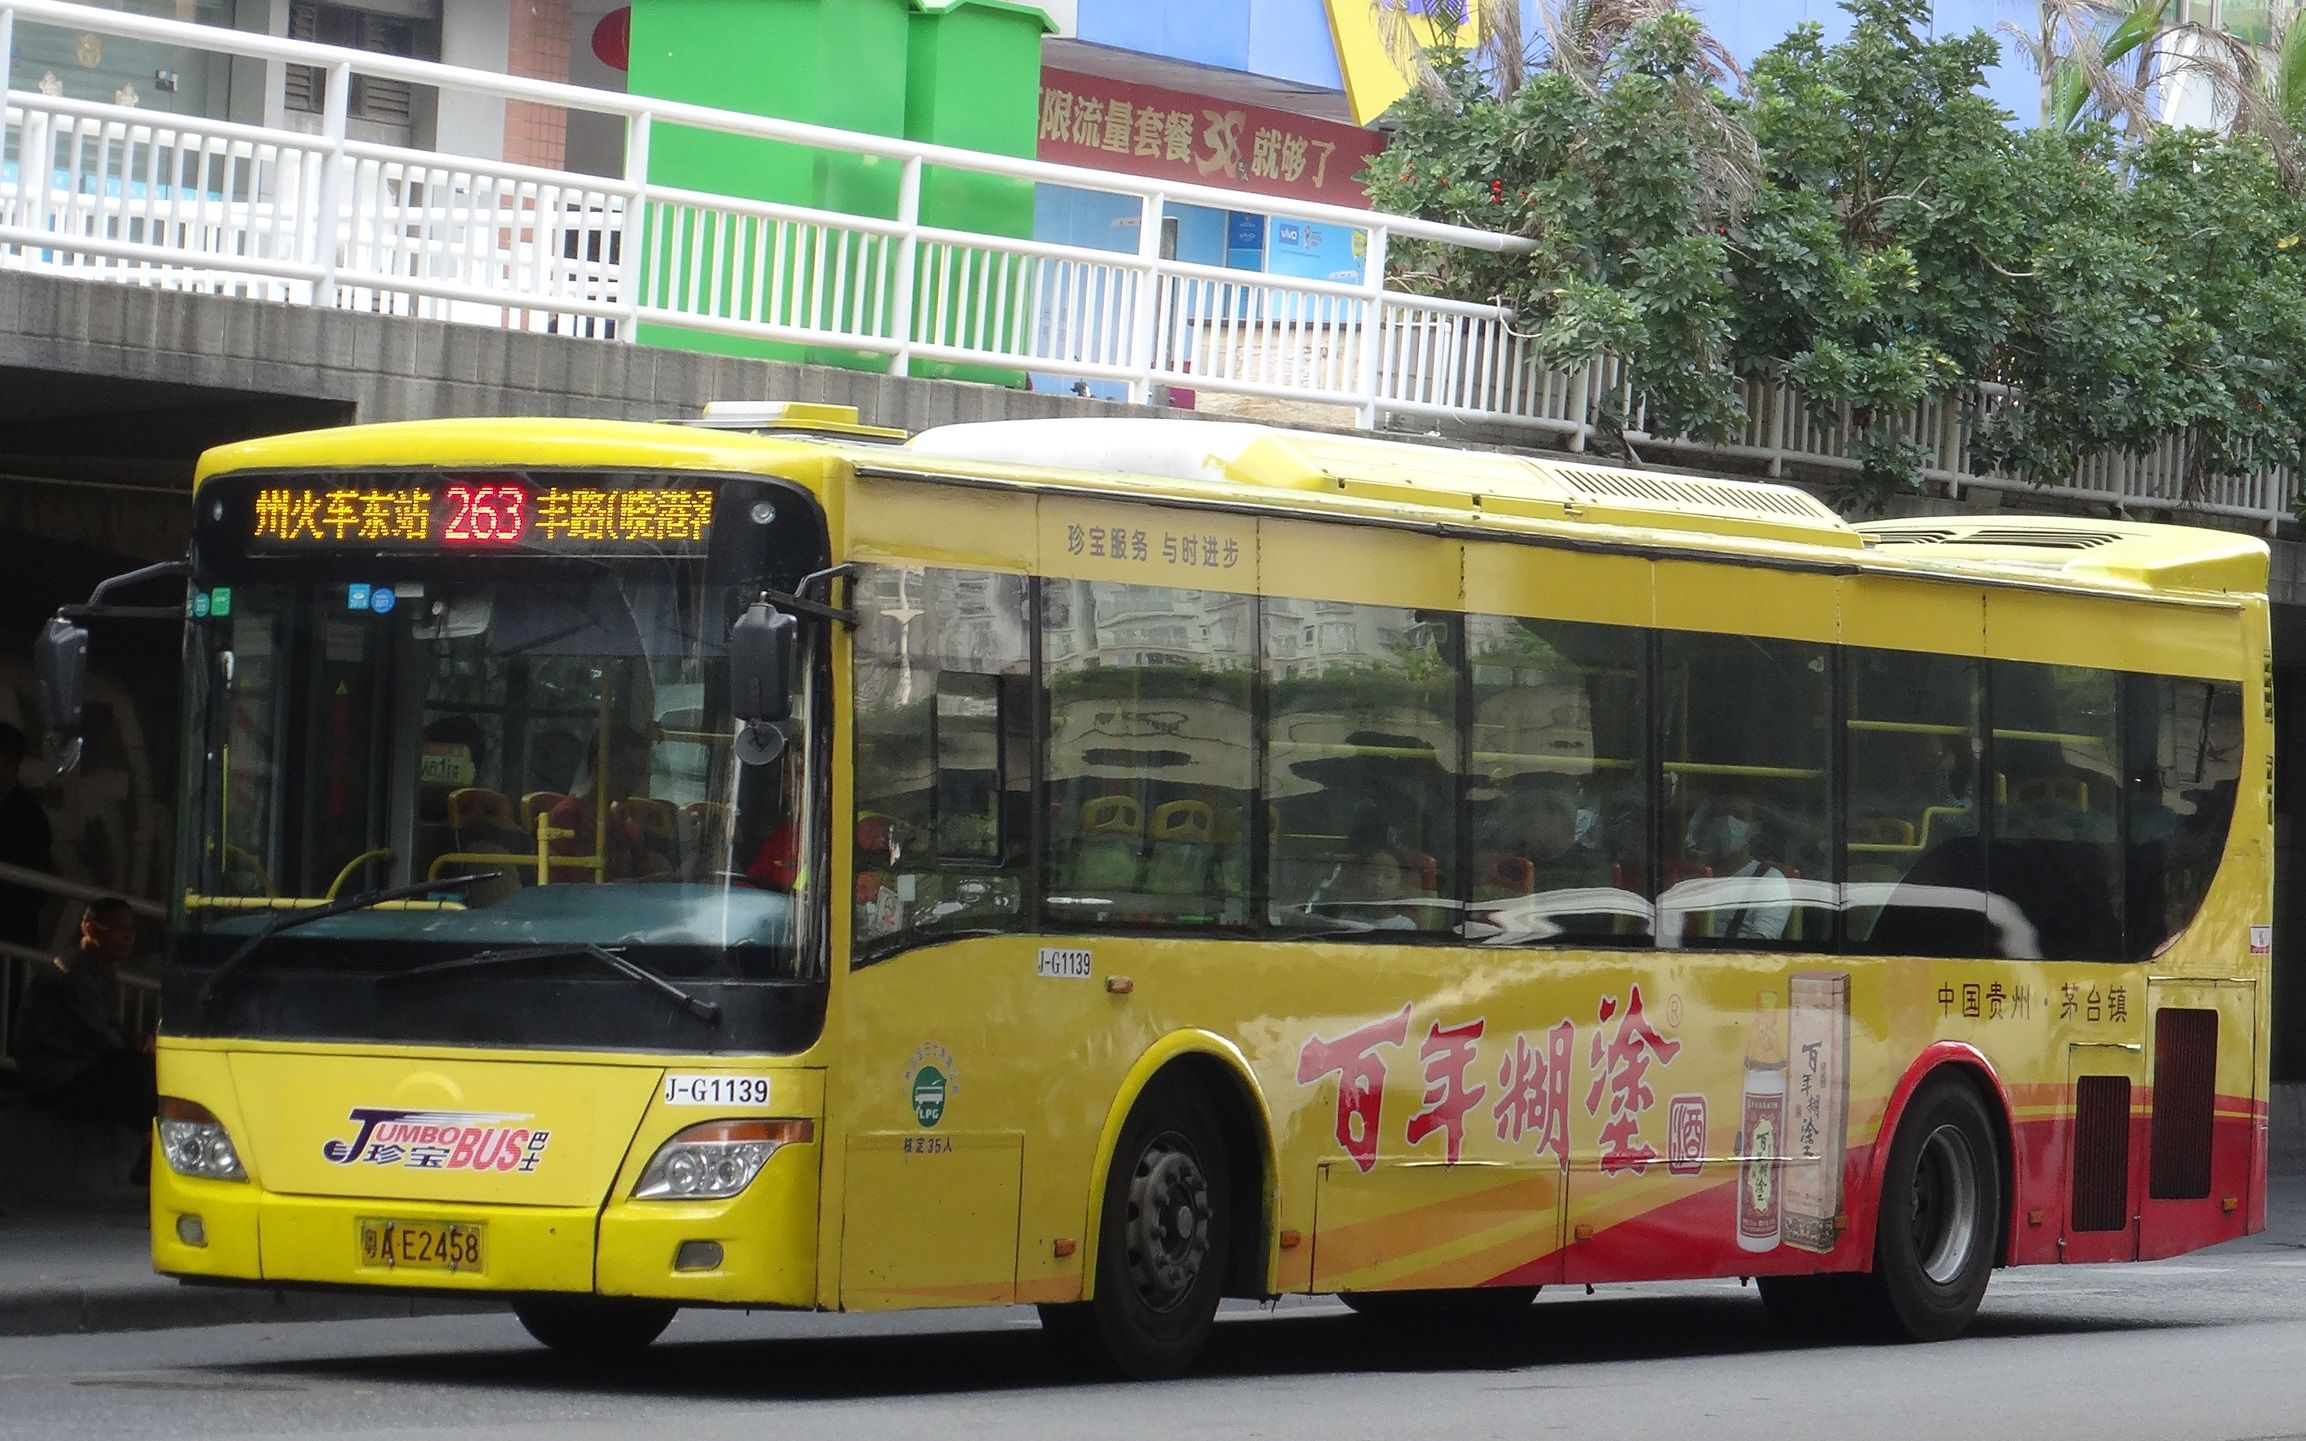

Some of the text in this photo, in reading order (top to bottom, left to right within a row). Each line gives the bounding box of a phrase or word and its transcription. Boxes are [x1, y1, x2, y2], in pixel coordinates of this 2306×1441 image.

[254, 487, 430, 539] 州火车东站
[445, 486, 524, 540] 263
[1067, 523, 1239, 568] 珍宝服务 与时进步
[1037, 950, 1091, 976] J-G1139
[665, 1078, 769, 1104] J-G1139
[919, 1108, 939, 1119] LPG
[363, 1145, 450, 1168] 珍宝
[518, 1131, 549, 1171] 巴士
